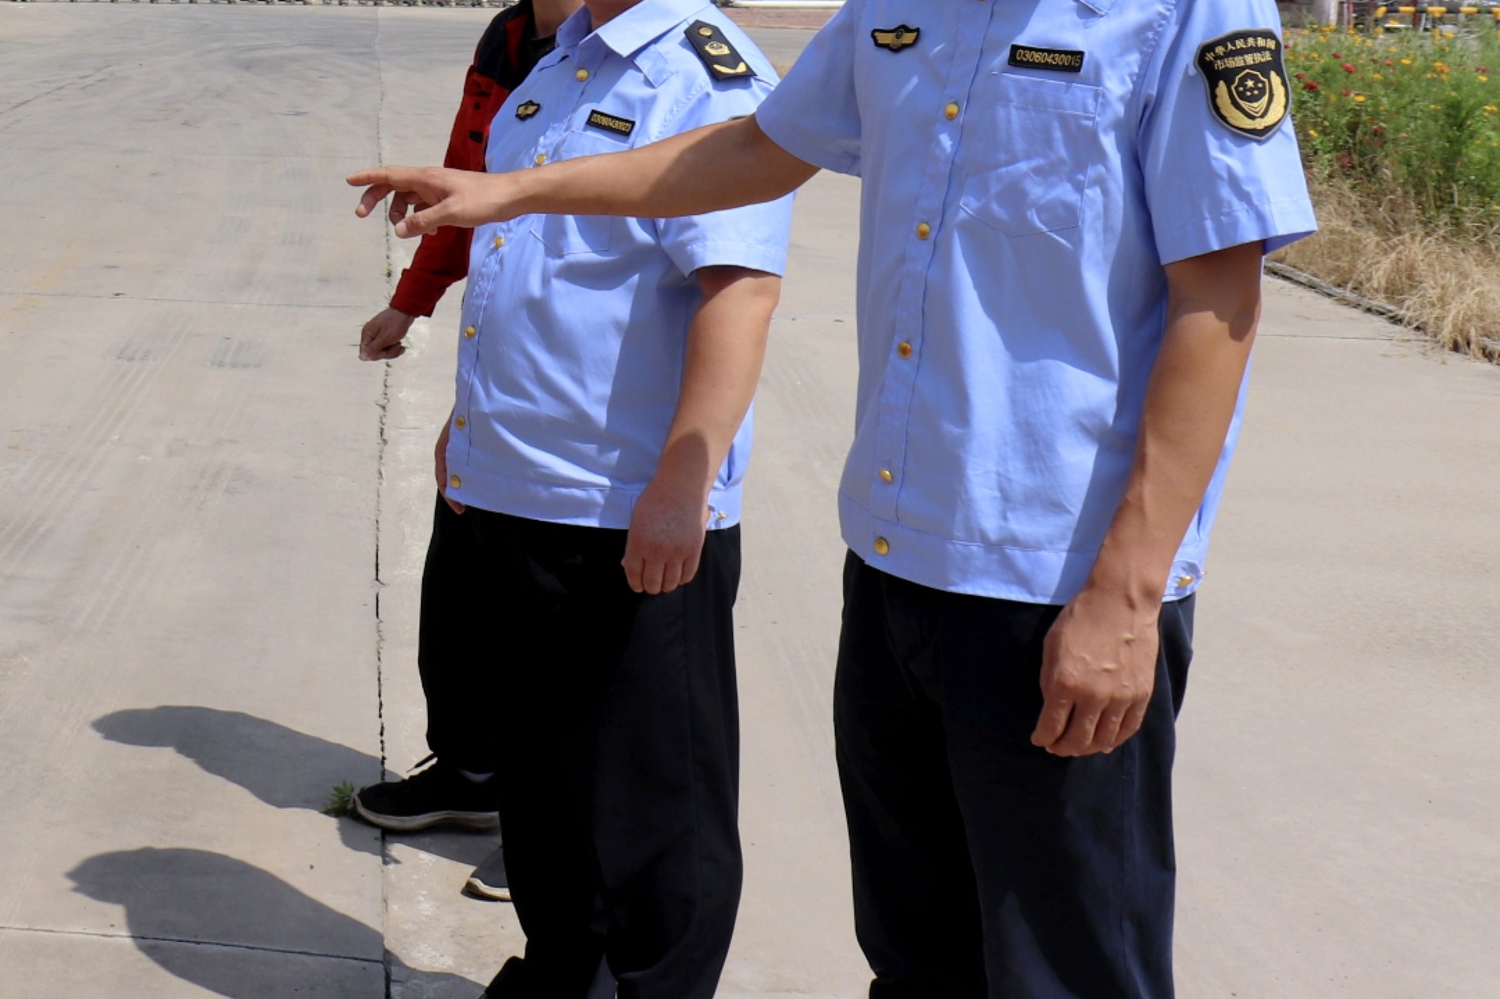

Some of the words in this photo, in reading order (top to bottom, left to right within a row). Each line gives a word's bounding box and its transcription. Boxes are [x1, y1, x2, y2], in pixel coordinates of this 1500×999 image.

[1204, 37, 1276, 62] 中华人民共和国
[1214, 50, 1273, 71] 市场监管执法
